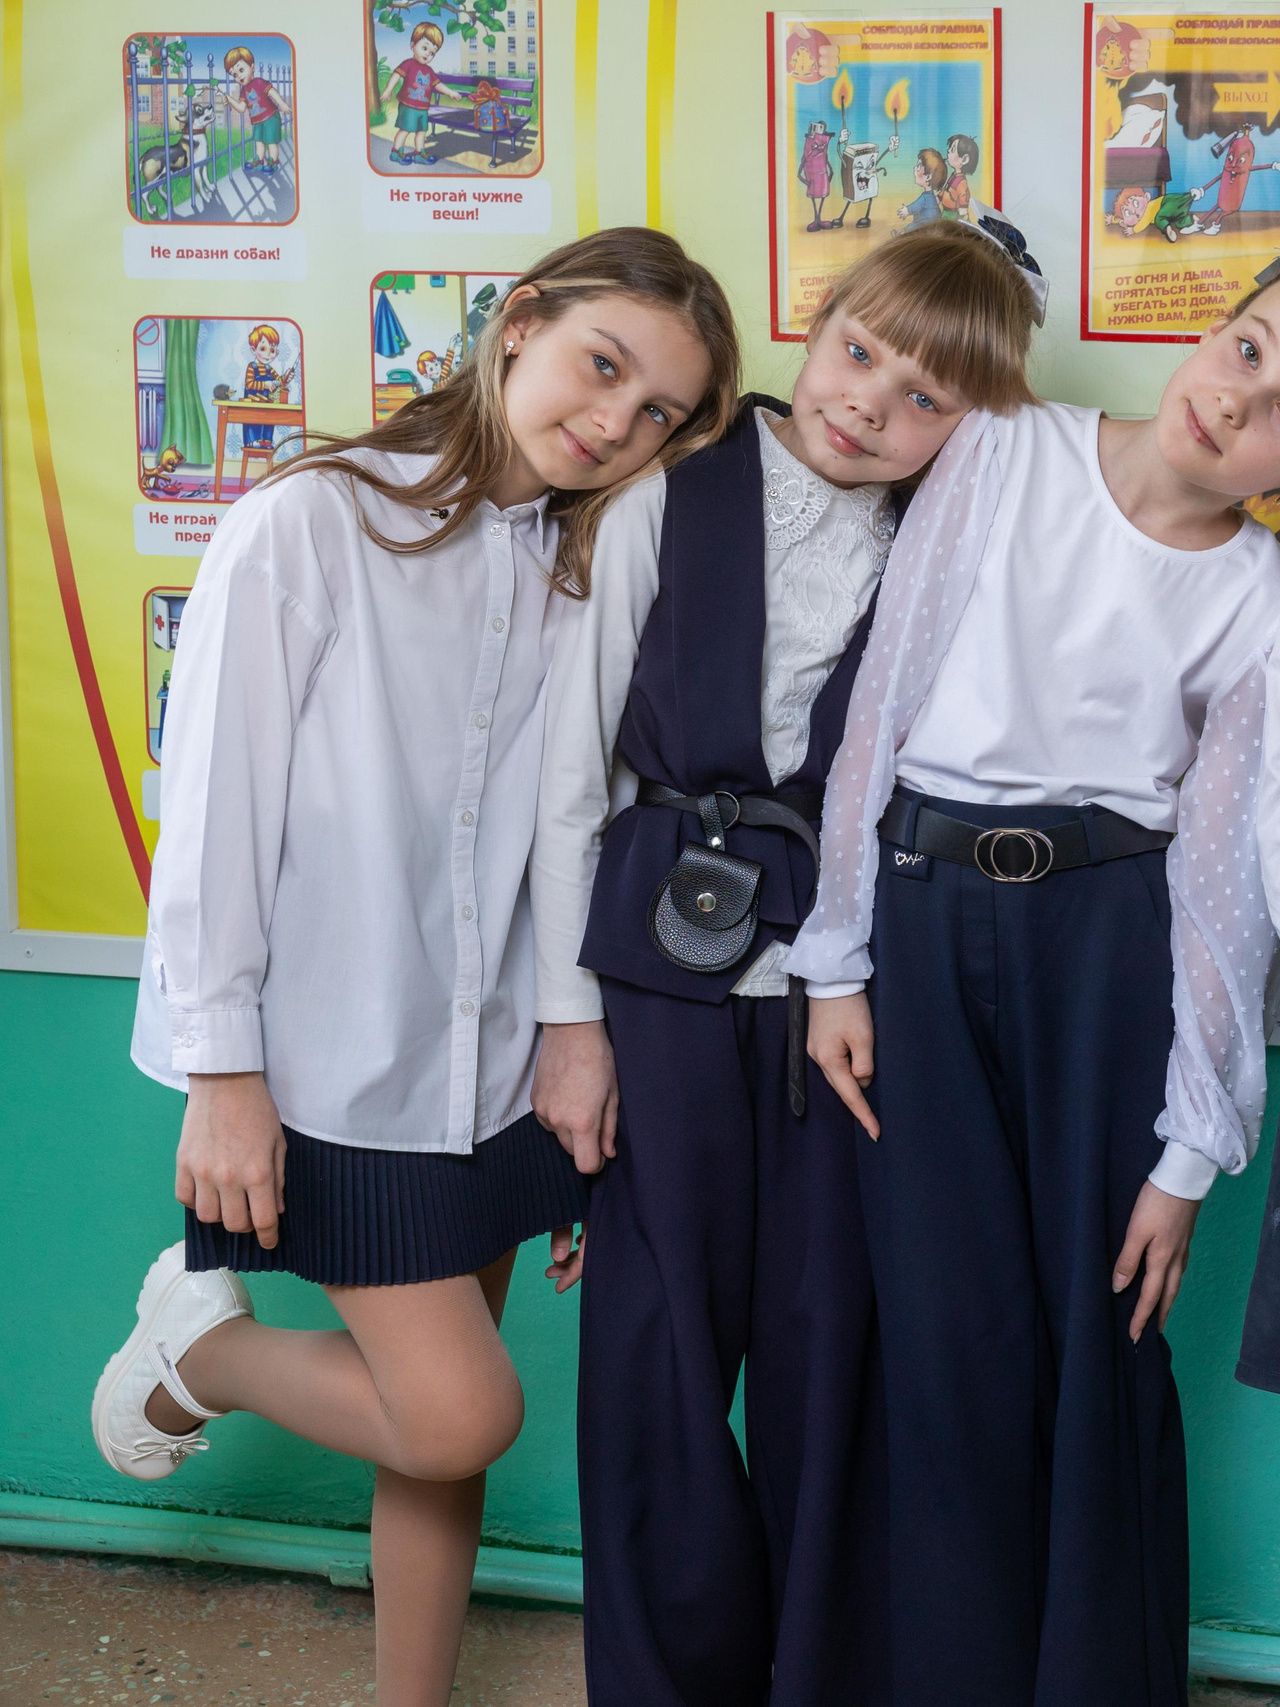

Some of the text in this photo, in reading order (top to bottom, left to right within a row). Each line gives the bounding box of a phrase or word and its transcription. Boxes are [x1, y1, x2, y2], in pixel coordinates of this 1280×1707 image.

[862, 24, 985, 35] СОБЛЮДАЙ ПРАВИЛА
[1175, 18, 1244, 30] СОБЛЮДАЙ
[1223, 91, 1268, 103] ВЫХОД
[390, 189, 523, 203] Не трогай чужие
[433, 208, 479, 220] вещи!
[151, 246, 280, 260] Не дразни собак!
[800, 276, 825, 287] ЕСЛИ
[1115, 269, 1223, 286] ОТ ОГНЯ И ДЫМА
[1105, 281, 1242, 300] СПРЯТАТЬСЯ НЕЛЬЗЯ.
[1113, 295, 1227, 313] УБЕГАТЬ ИЗ ДОМА
[1108, 314, 1153, 326] НУЖНО
[1156, 311, 1186, 322] ВАМ,
[149, 512, 217, 525] Не играй
